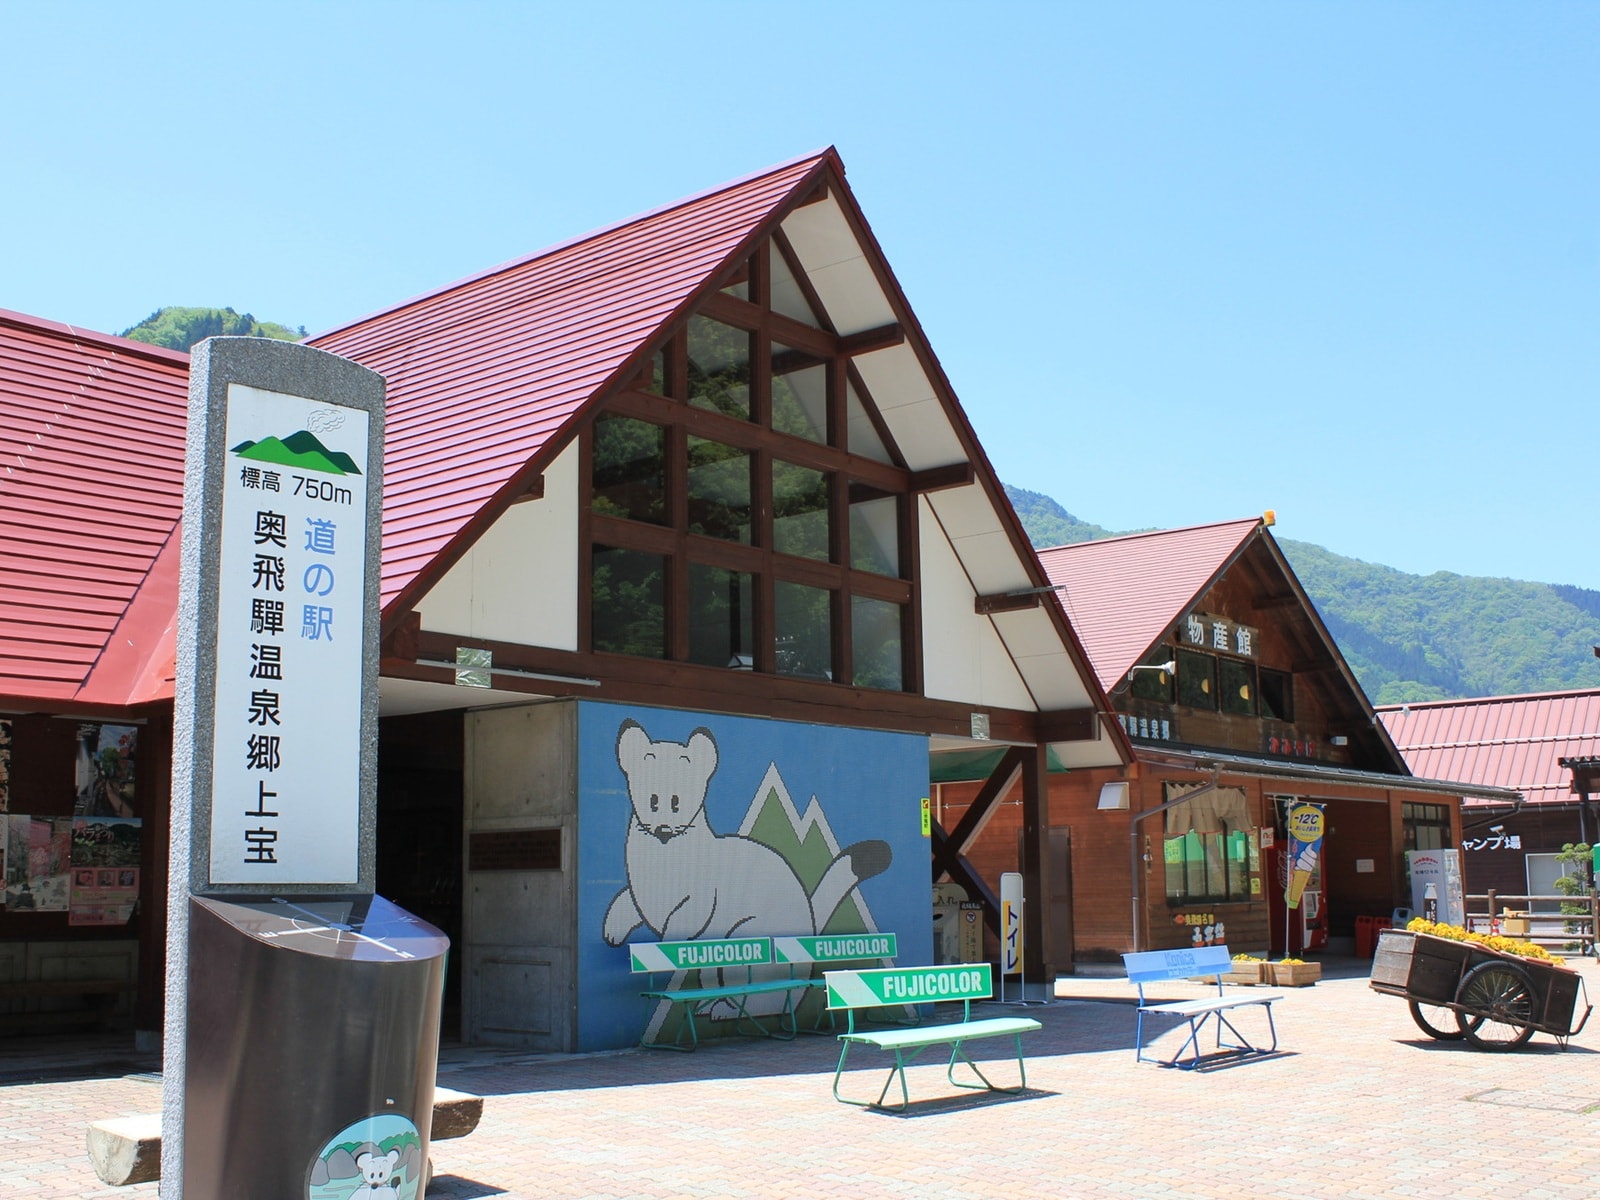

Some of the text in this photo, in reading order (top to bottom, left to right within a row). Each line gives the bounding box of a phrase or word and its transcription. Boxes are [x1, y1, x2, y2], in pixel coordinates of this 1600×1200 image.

[240, 466, 352, 506] 標高 750m
[301, 517, 337, 642] 道の駅
[1187, 615, 1252, 656] 物産館
[677, 941, 764, 965] FUJICOLOR
[814, 936, 890, 957] FUJICOLOR
[1007, 904, 1019, 970] トイレ
[1164, 950, 1196, 967] Konica
[882, 970, 983, 999] FUJICOLOR
